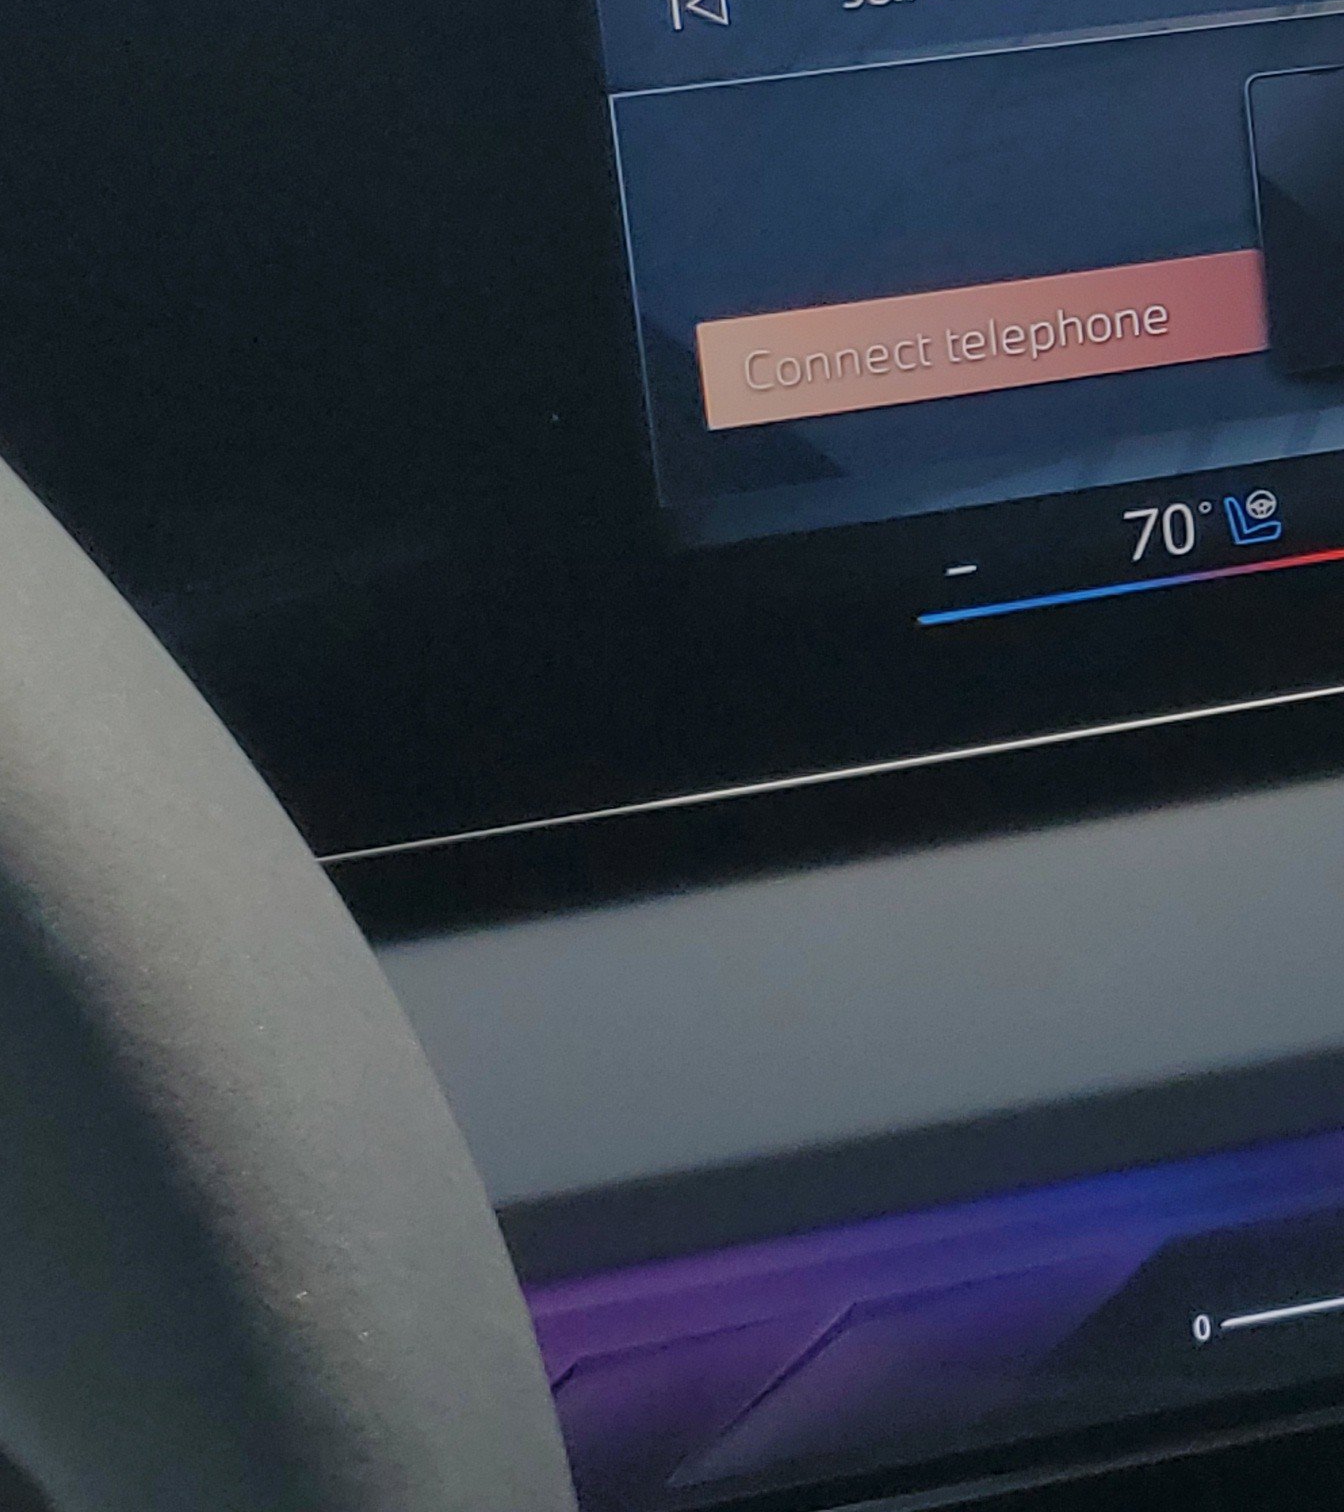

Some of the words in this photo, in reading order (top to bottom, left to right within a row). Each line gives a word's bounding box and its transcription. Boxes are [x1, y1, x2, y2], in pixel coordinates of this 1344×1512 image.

[744, 334, 932, 391] Connect
[946, 304, 1169, 360] telephone
[1191, 1314, 1212, 1341] 0
